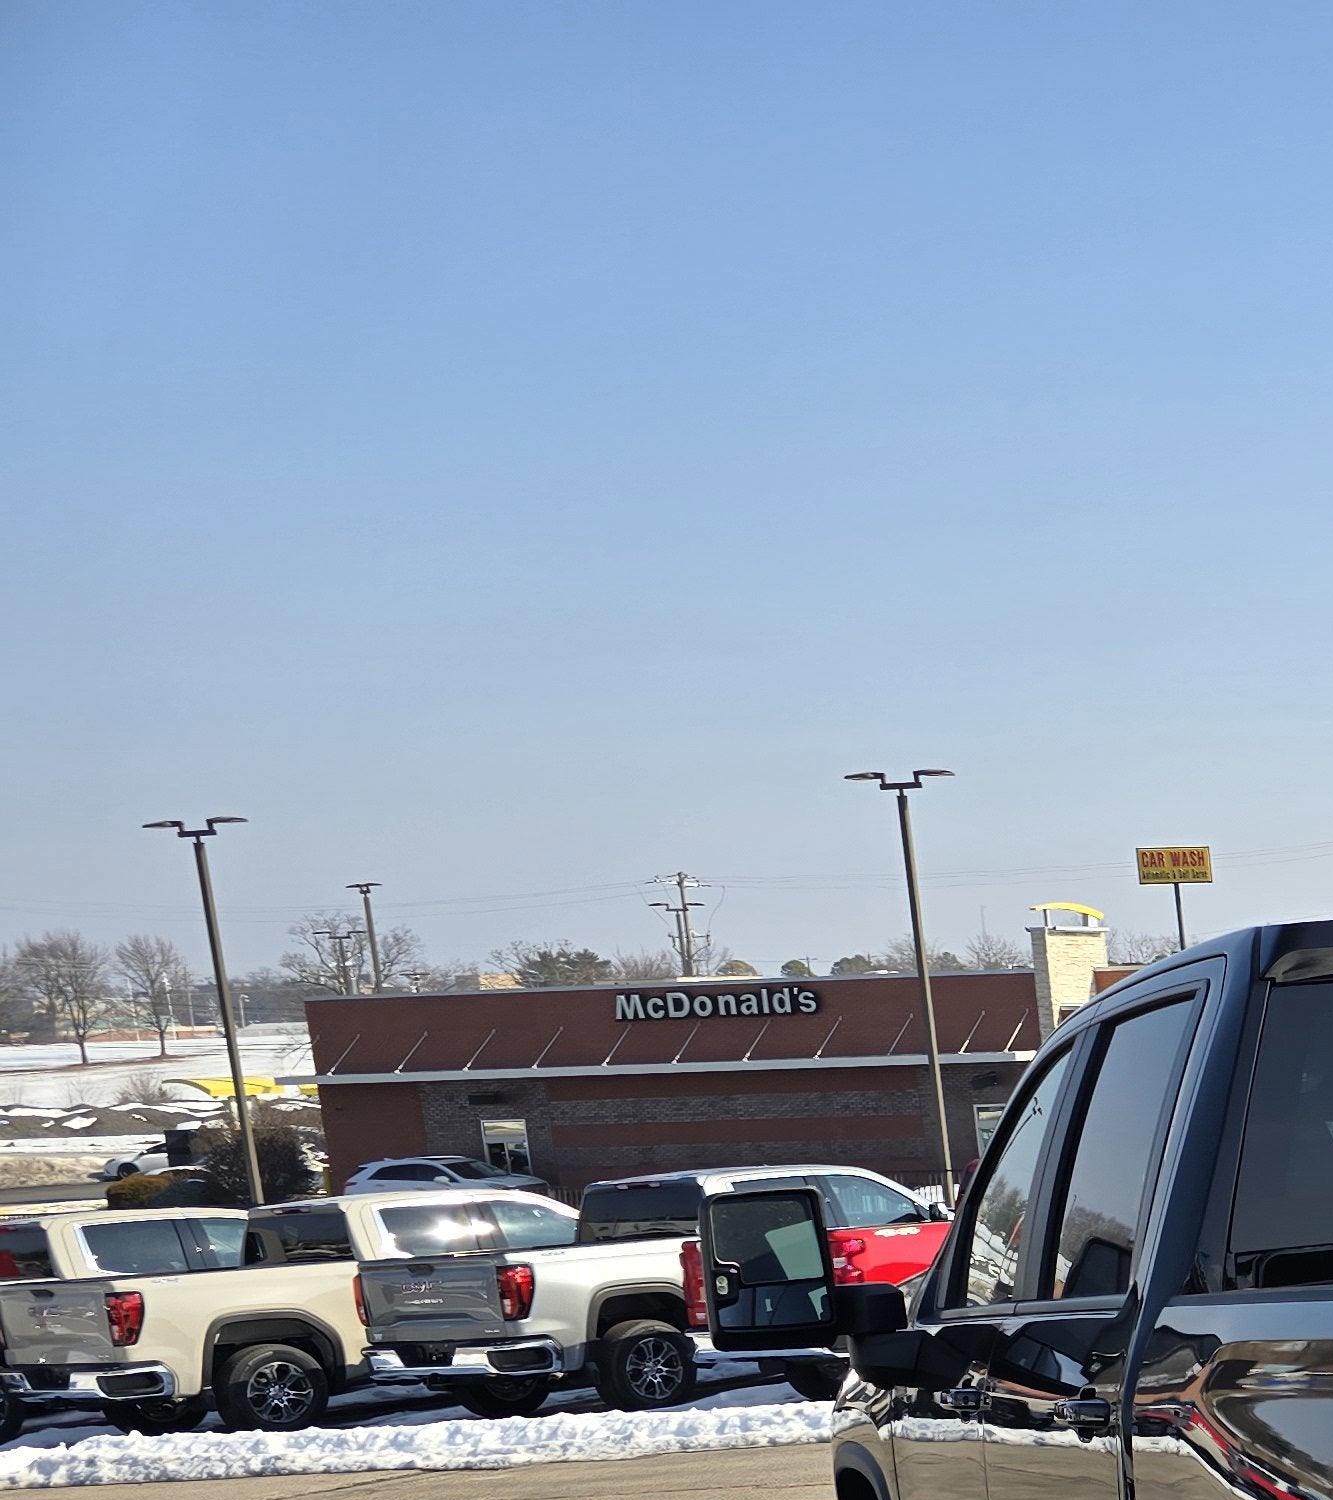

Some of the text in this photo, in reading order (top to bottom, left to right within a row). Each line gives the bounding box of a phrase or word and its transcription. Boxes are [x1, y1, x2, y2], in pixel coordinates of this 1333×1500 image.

[1142, 850, 1205, 868] CAR WASH
[615, 987, 817, 1020] McDonald's
